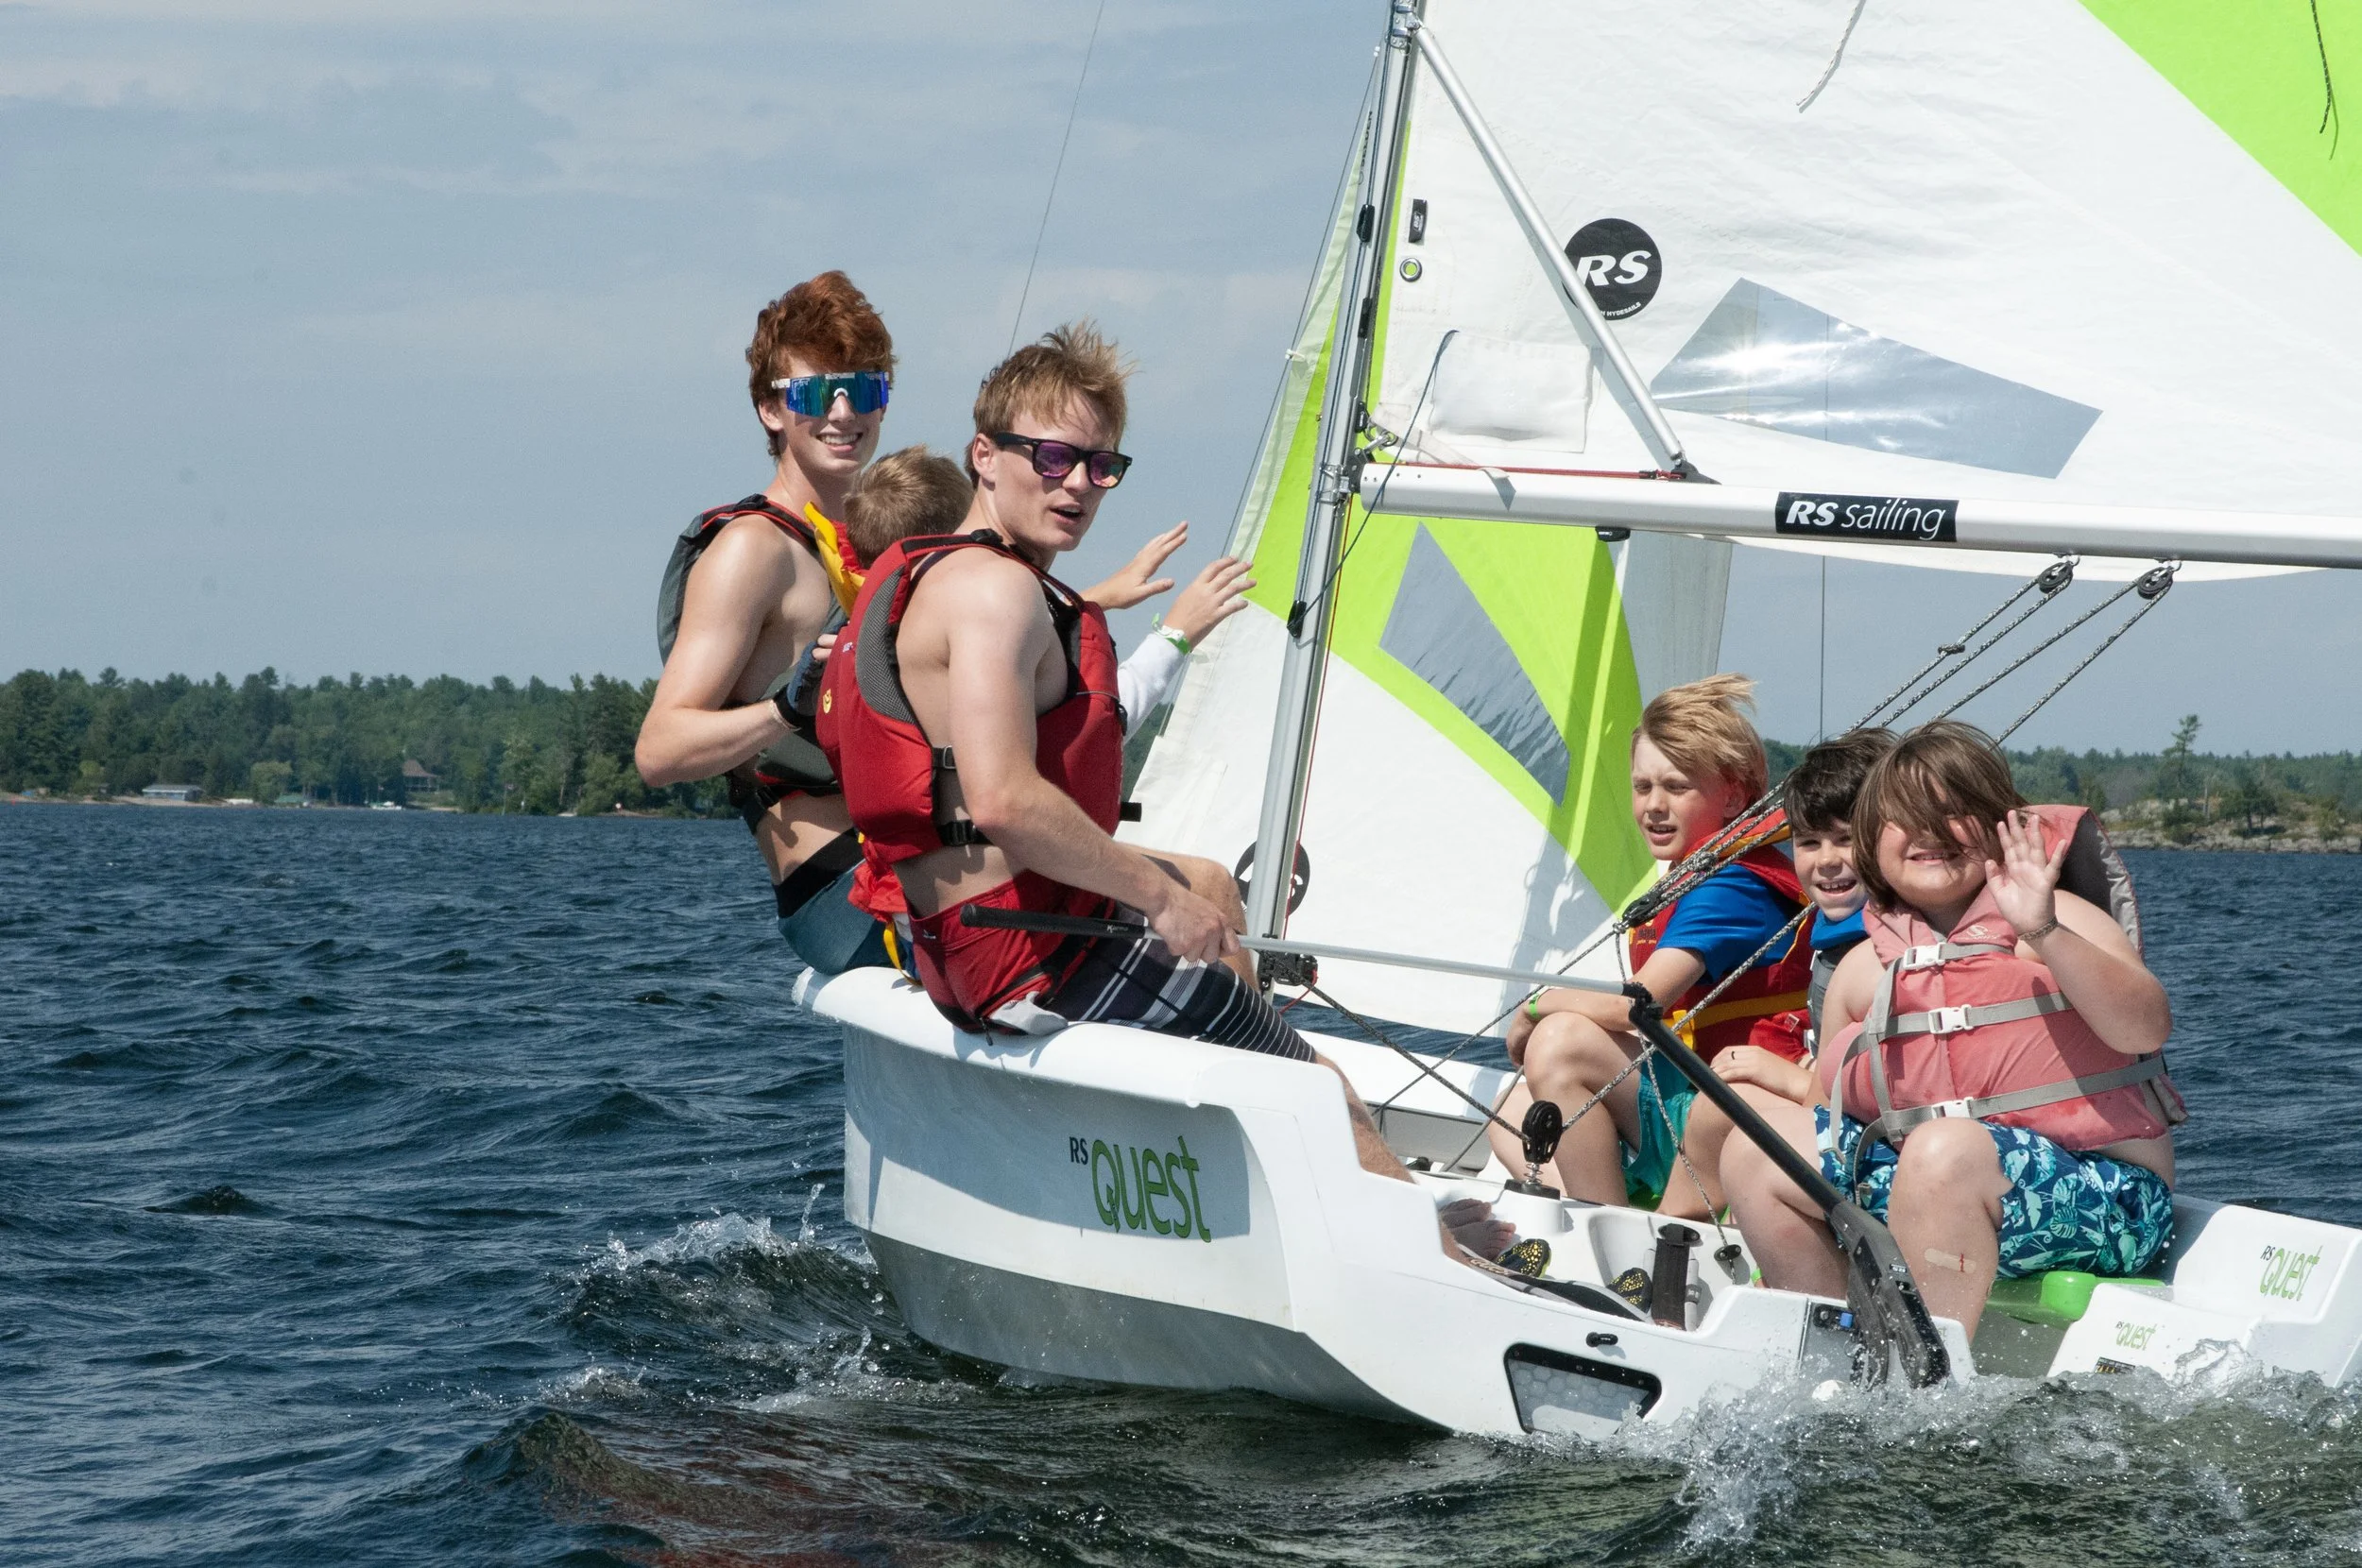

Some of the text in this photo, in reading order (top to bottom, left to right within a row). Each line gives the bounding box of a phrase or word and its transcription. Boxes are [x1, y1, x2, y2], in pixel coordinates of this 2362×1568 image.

[1576, 249, 1652, 287] RS
[1786, 497, 1946, 541] RS sailing
[1069, 1134, 1212, 1243] RS Quest
[2260, 1245, 2276, 1261] RS
